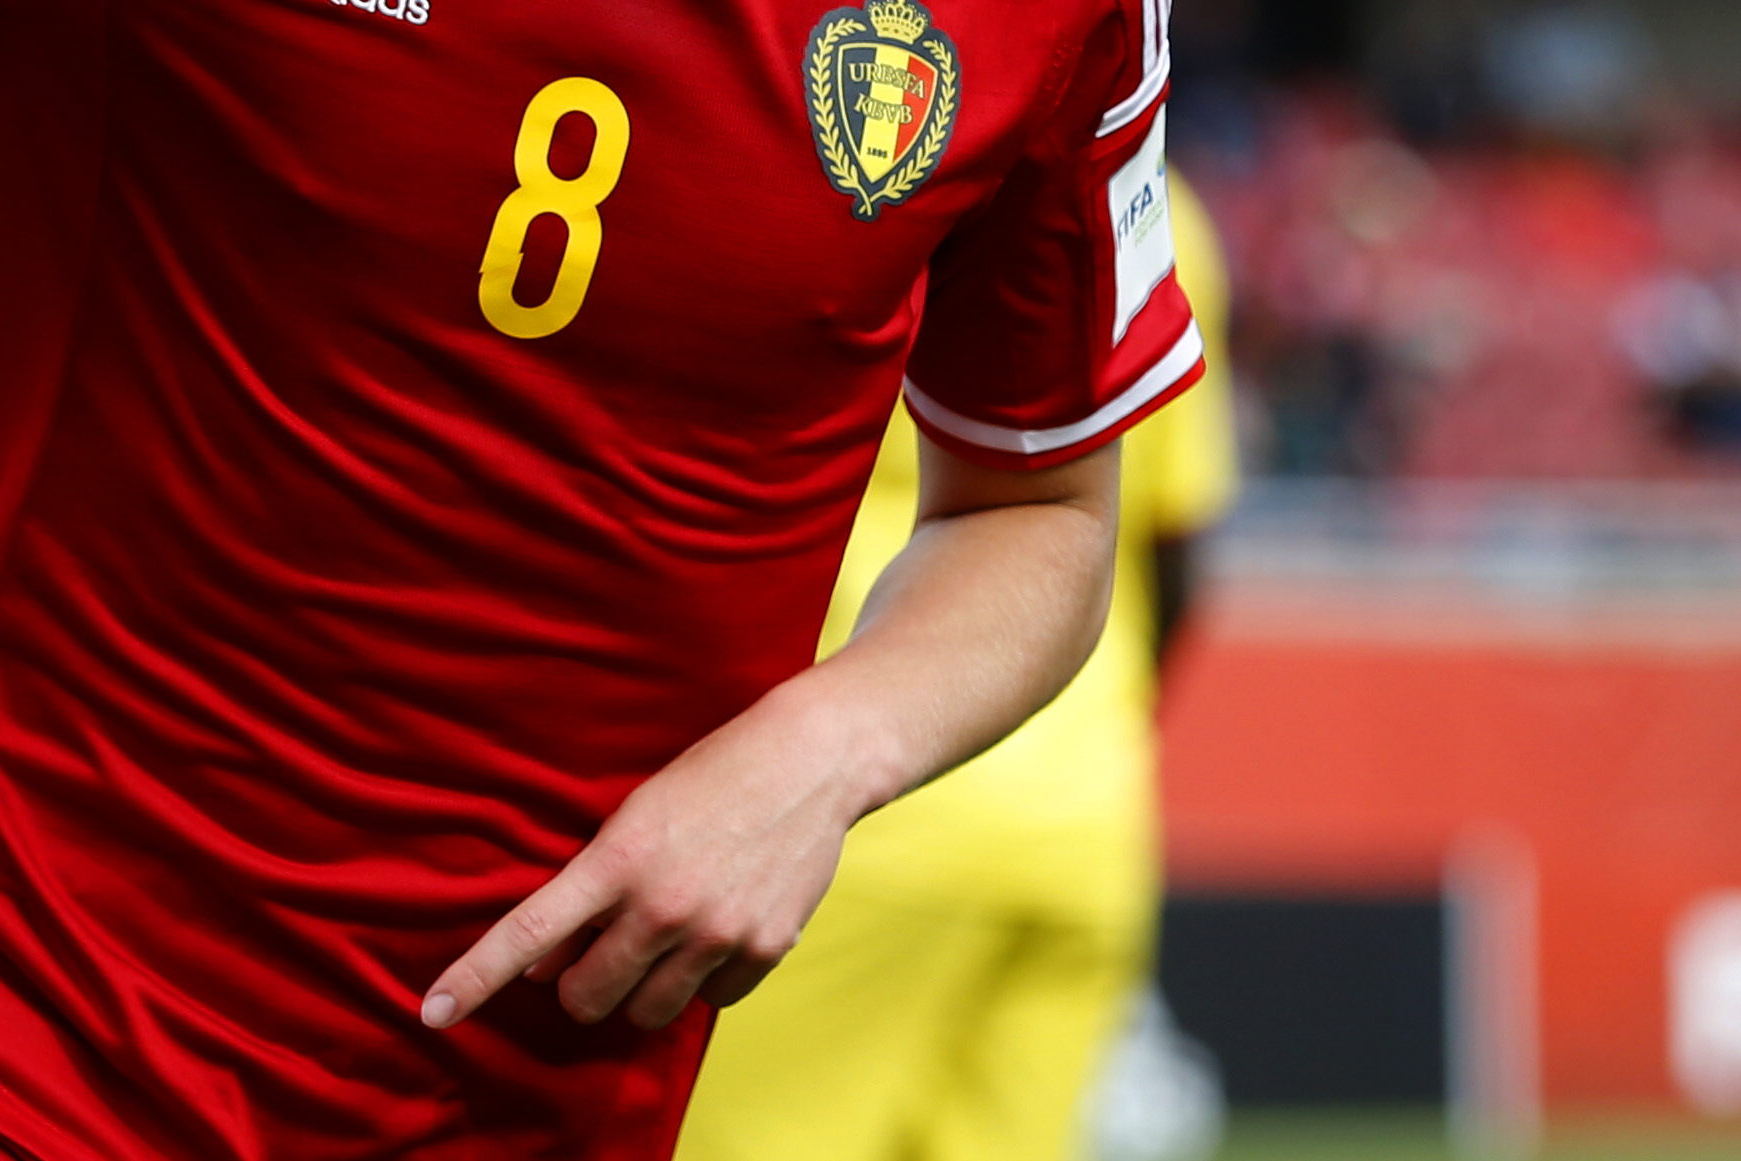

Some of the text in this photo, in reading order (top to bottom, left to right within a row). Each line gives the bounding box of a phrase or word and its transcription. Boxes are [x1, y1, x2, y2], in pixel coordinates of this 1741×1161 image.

[848, 62, 926, 100] URBSFA
[853, 92, 914, 125] KBVB
[478, 76, 631, 340] 8
[1117, 181, 1155, 253] FIFA
